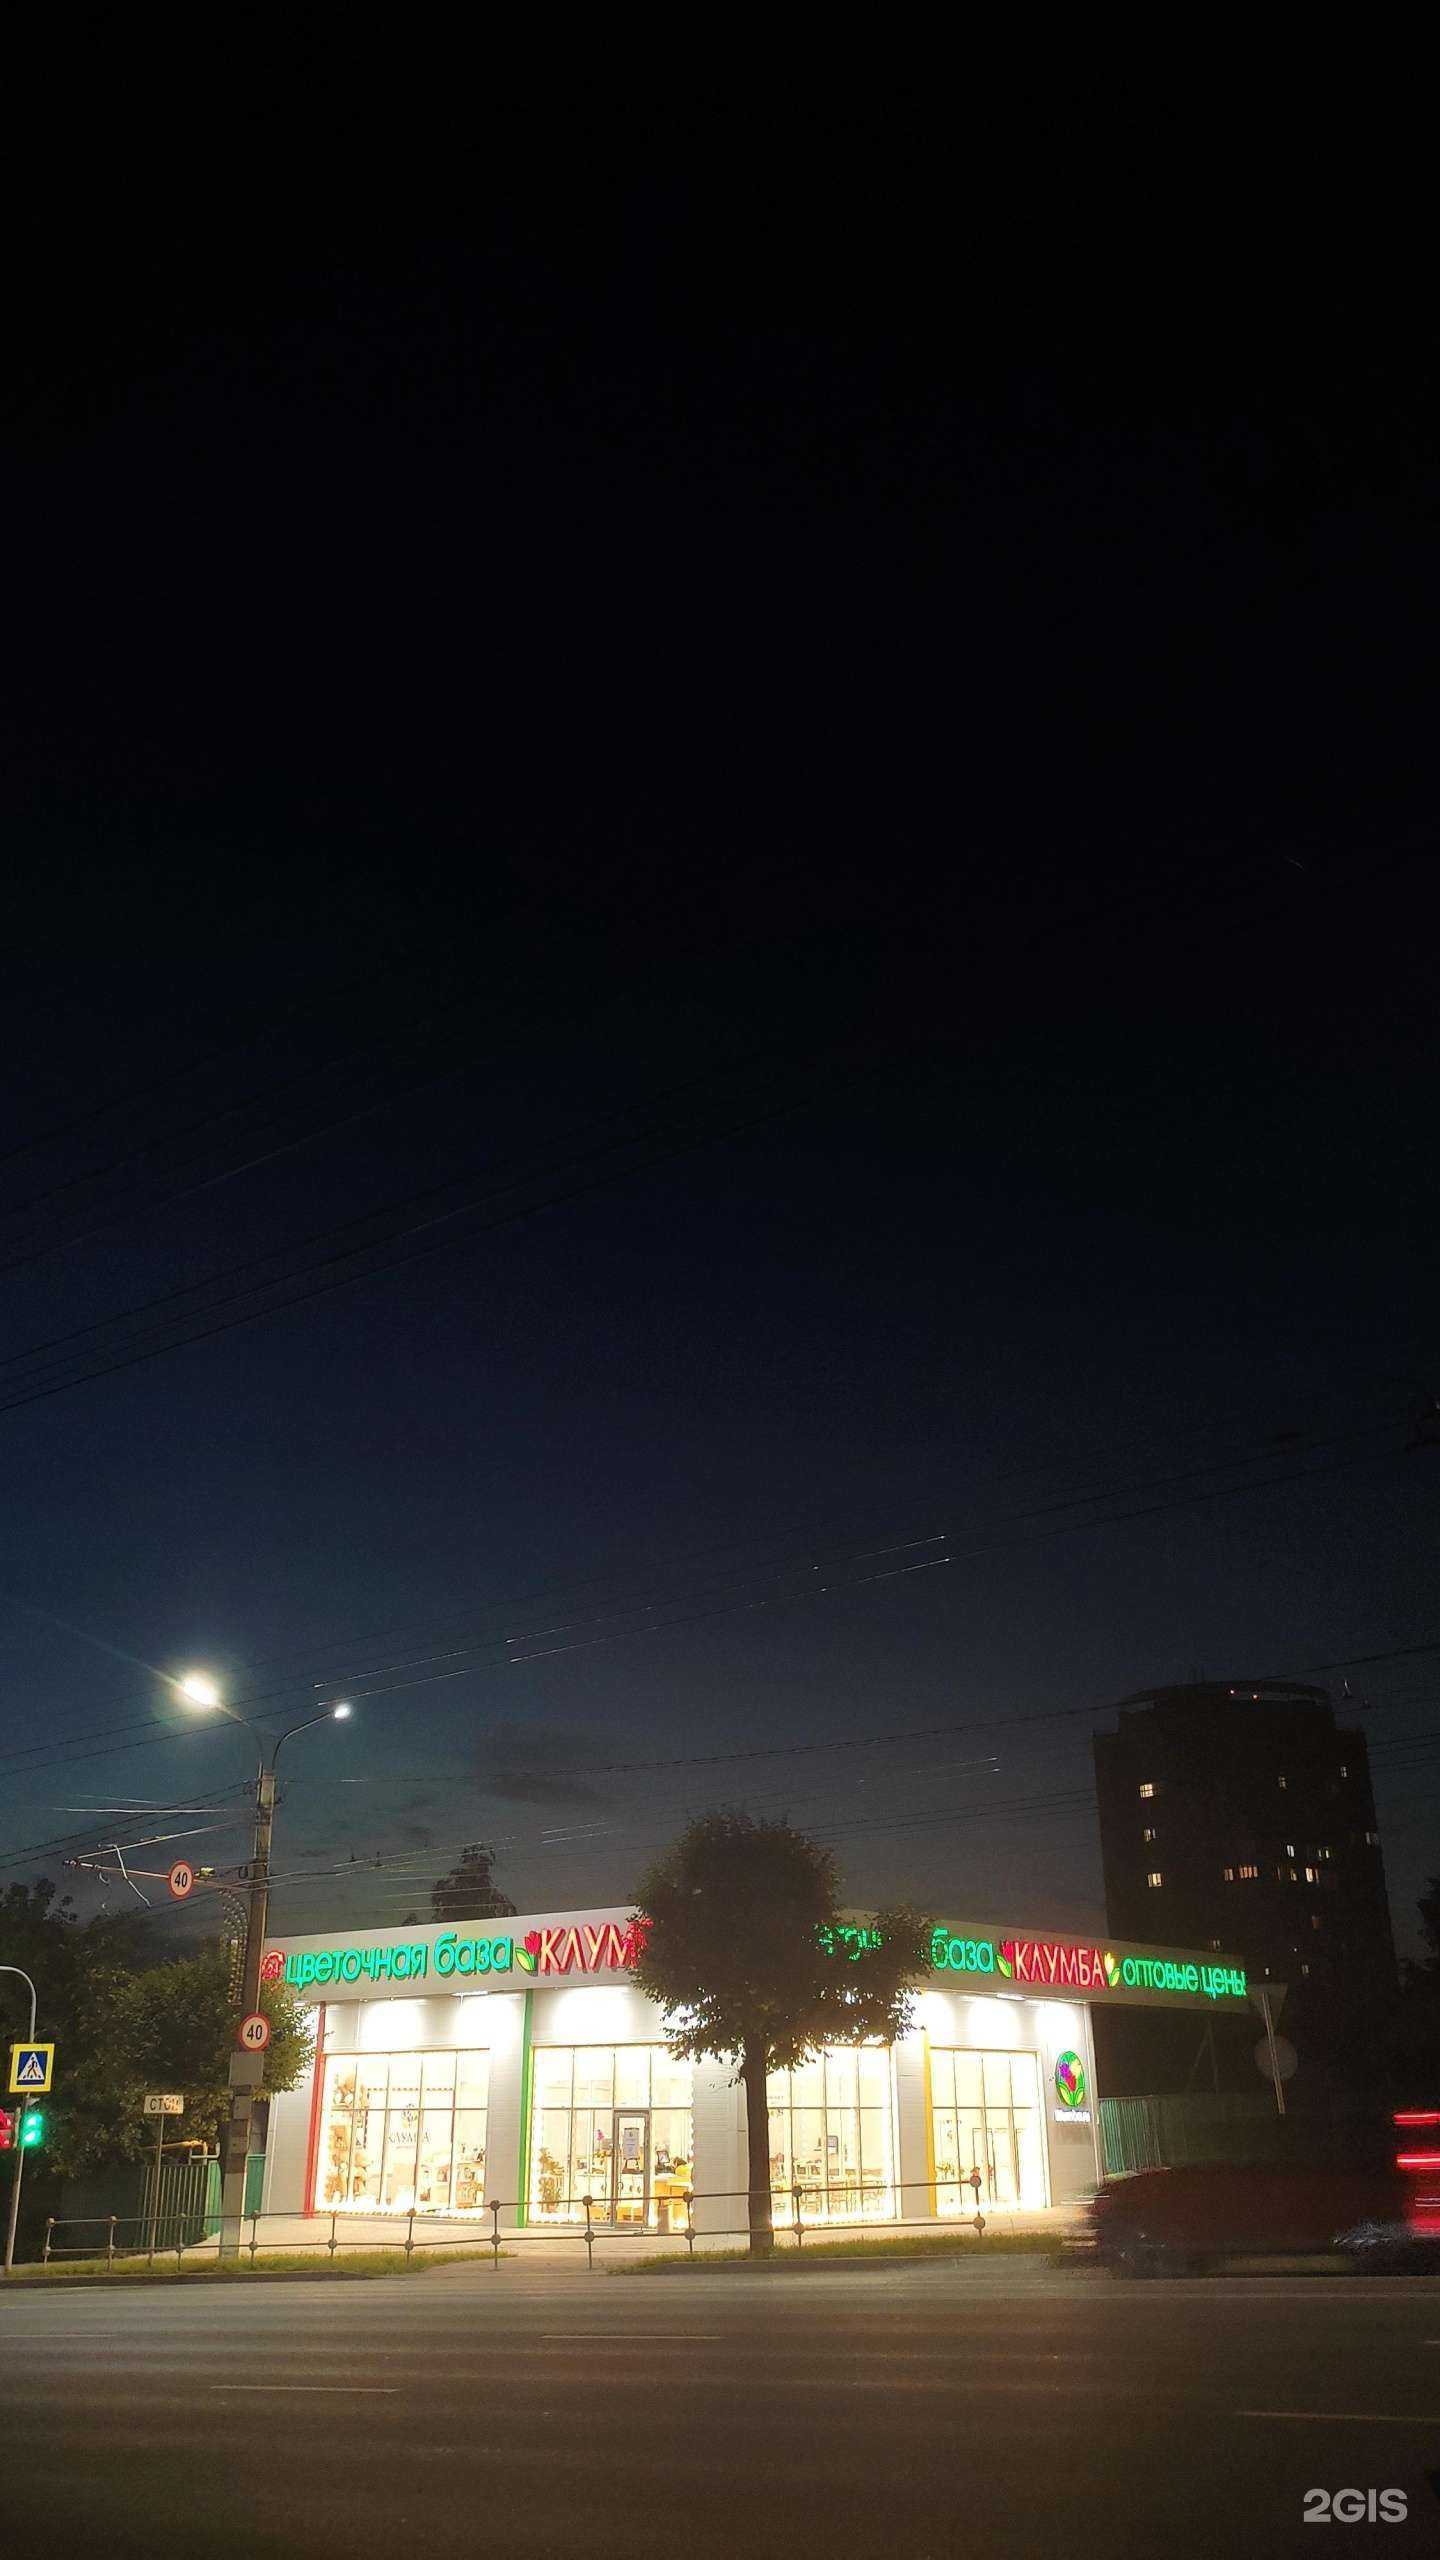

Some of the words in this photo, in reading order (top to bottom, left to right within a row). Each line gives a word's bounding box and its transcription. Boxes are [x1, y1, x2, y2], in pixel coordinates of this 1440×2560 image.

[173, 1871, 188, 1889] 40
[286, 1943, 428, 1989] цветочная
[434, 1931, 513, 1976] база
[540, 1919, 650, 1973] КЛУМ
[931, 1927, 994, 1973] база
[1013, 1941, 1106, 1987] КЛУМБА
[1122, 1957, 1199, 1992] оптовые
[1200, 1966, 1247, 1999] цены
[246, 2023, 263, 2041] 40
